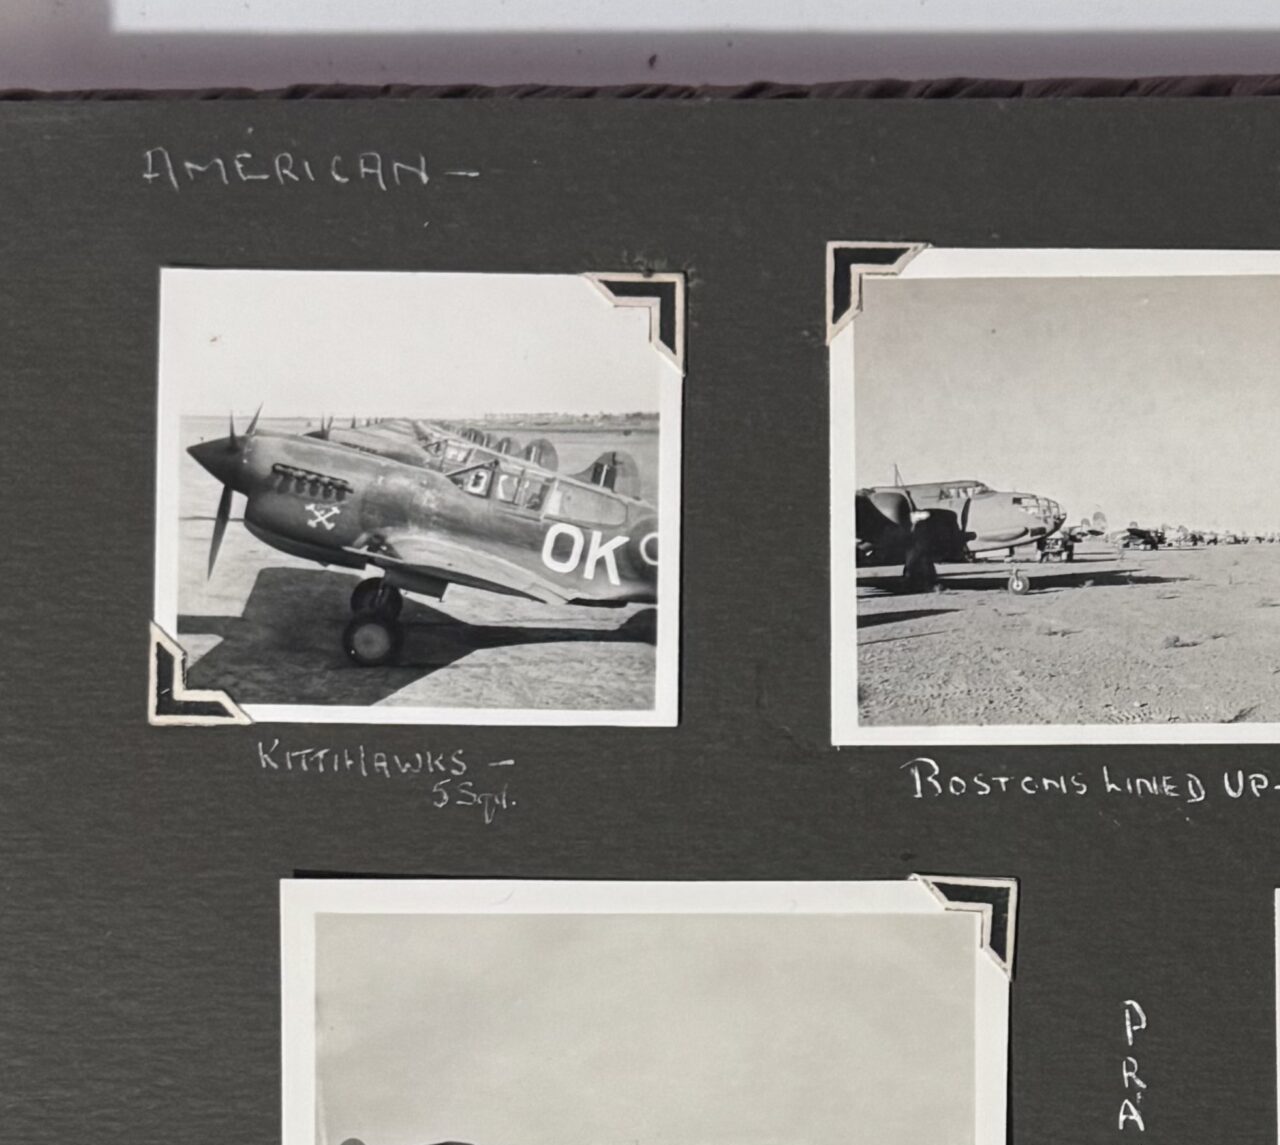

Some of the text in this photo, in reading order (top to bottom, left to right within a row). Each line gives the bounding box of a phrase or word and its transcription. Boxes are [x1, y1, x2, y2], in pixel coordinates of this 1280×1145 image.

[143, 147, 429, 191] AMERICAN
[541, 522, 631, 586] OK
[433, 779, 451, 808] 5
[900, 757, 1087, 798] BOSTONS
[1103, 766, 1205, 803] LINED
